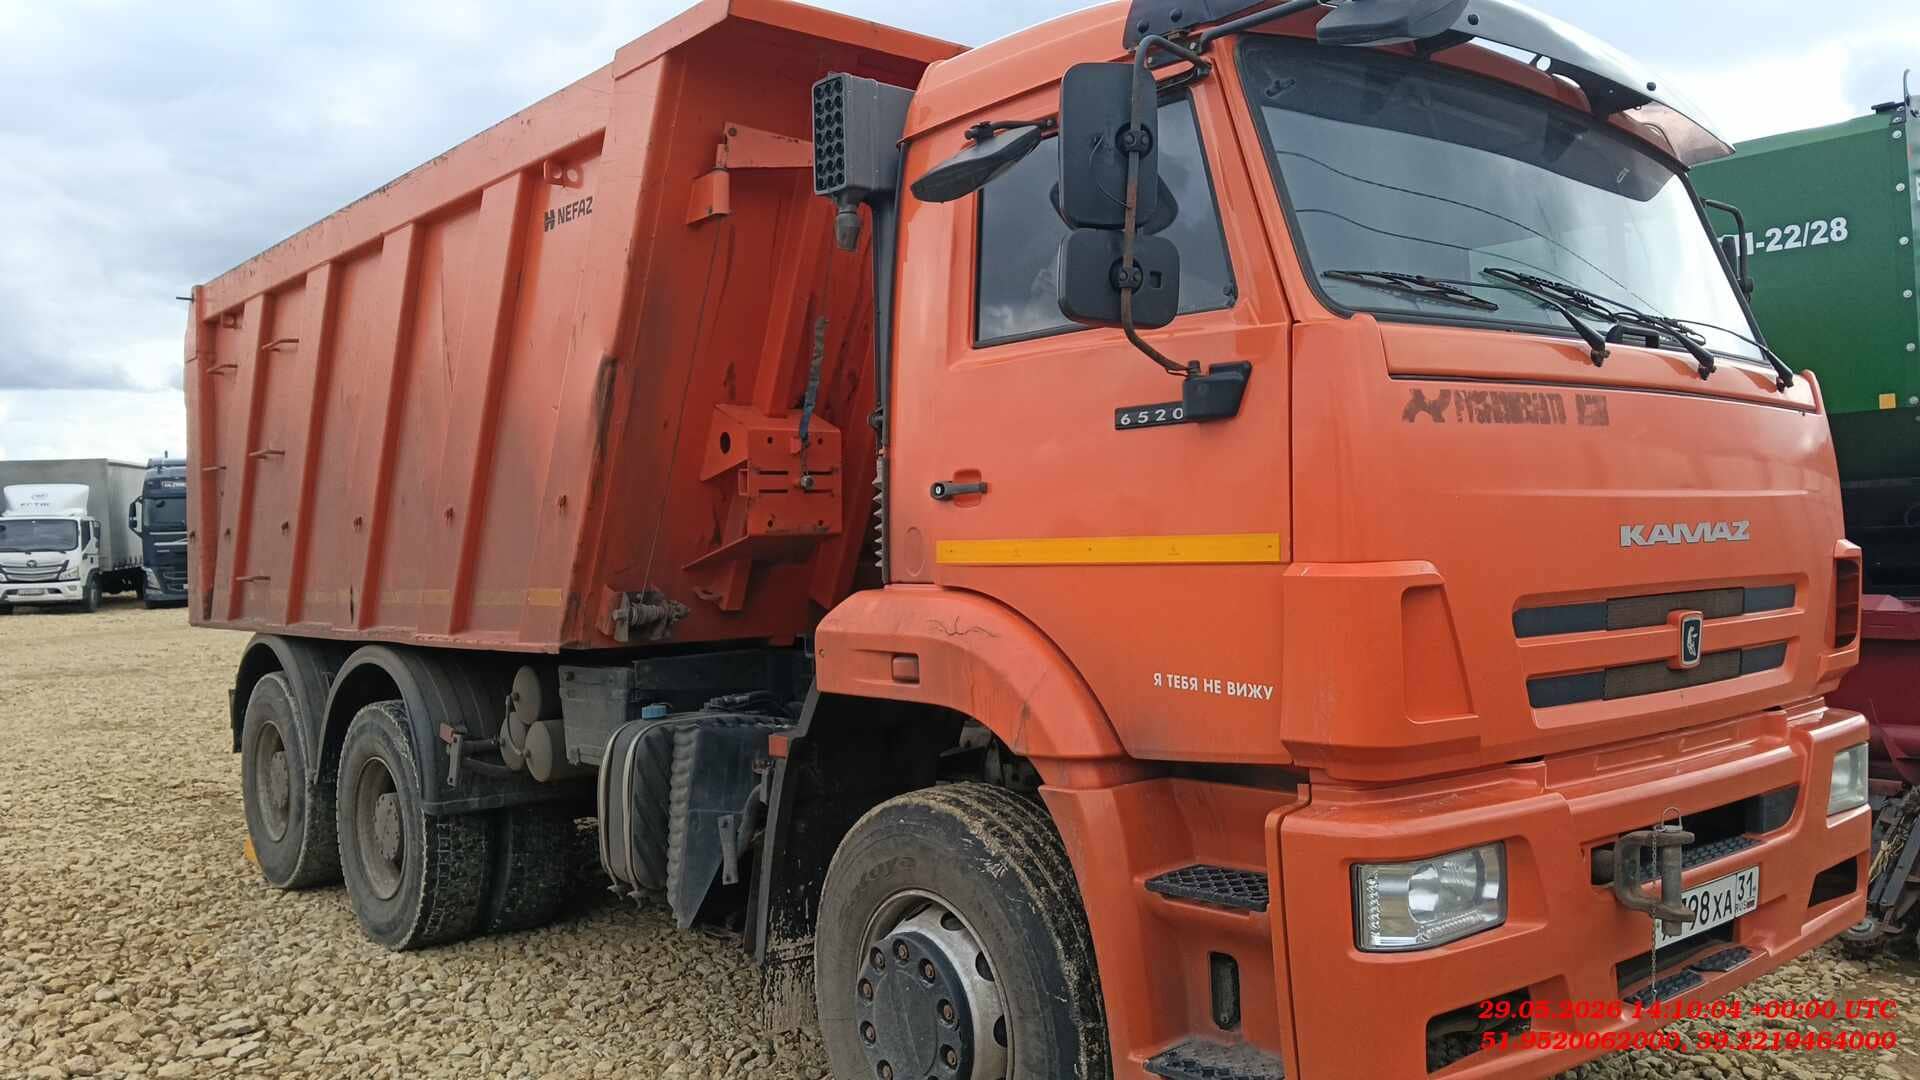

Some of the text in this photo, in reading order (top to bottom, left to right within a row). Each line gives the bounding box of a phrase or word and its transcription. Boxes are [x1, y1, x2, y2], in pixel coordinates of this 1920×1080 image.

[557, 196, 593, 225] NEFAZ
[1120, 407, 1184, 426] 6520
[1620, 520, 1751, 547] KAMAZ
[1153, 673, 1274, 701] Я ТЕБЯ НЕ ВИЖУ
[1737, 872, 1753, 902] 31
